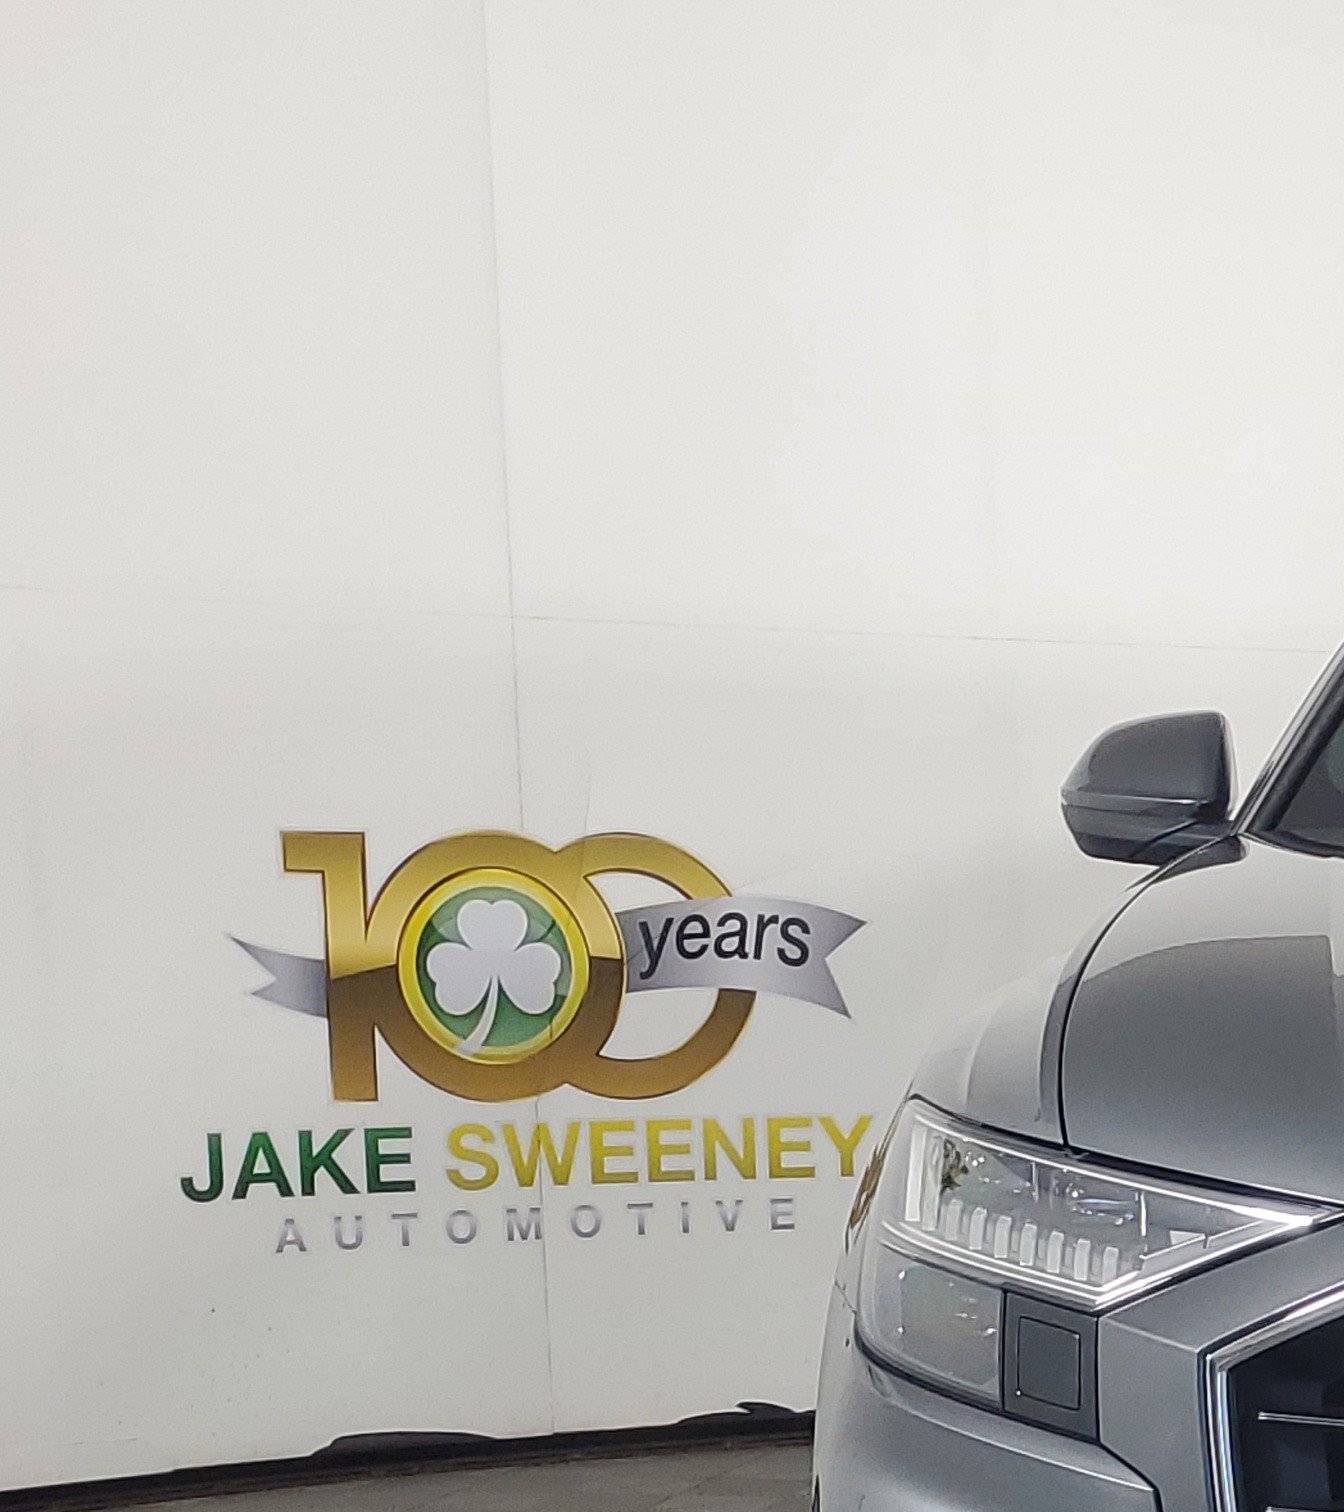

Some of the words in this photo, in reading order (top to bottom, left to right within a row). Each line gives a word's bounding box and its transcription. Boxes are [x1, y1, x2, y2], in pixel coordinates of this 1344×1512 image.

[280, 830, 756, 1102] 100
[638, 911, 811, 980] years
[180, 1126, 416, 1202] JAKE
[446, 1116, 873, 1190] SWEENEY
[275, 1198, 796, 1254] AUTOMOTIVE
